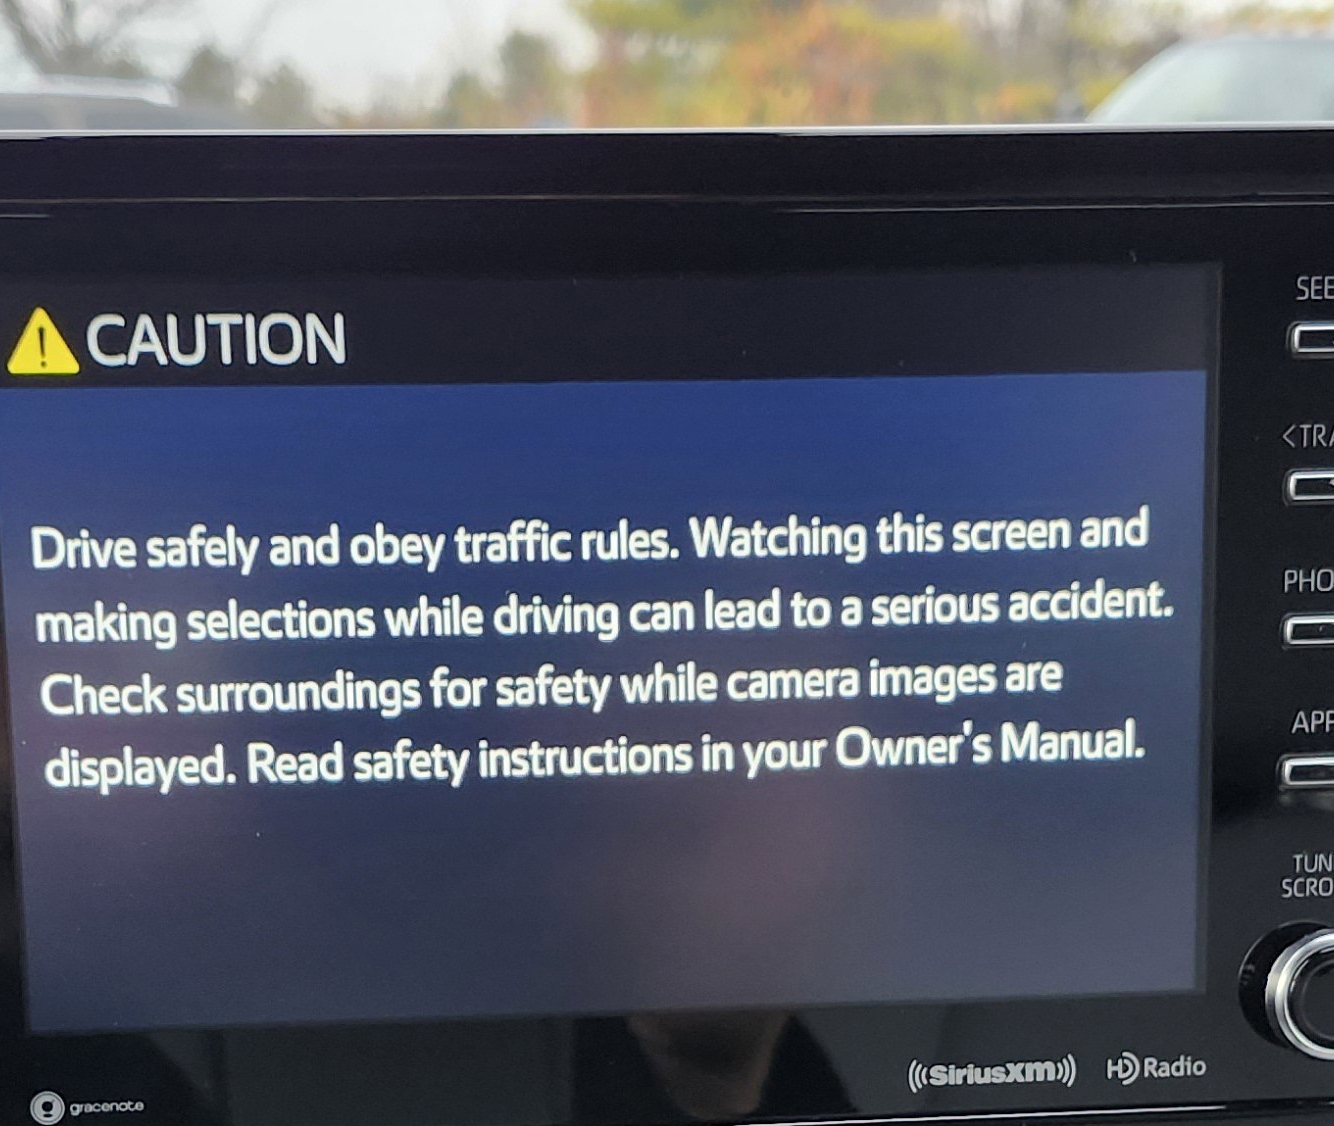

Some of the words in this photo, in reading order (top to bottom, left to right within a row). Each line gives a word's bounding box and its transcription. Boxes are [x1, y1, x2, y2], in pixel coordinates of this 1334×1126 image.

[85, 311, 348, 367] CAUTION
[31, 525, 137, 570] Drive
[147, 524, 259, 575] safely
[269, 523, 339, 565] and
[350, 523, 445, 572] obey
[455, 519, 571, 564] traffic
[582, 518, 679, 560] rules.
[689, 514, 867, 564] Watching
[877, 511, 943, 554] this
[952, 516, 1070, 552] screen
[1080, 505, 1150, 549] and
[36, 601, 176, 650] making
[187, 599, 375, 641] selections
[384, 595, 483, 637] while
[494, 592, 619, 641] driving
[629, 599, 694, 632] can
[704, 588, 780, 631] lead
[791, 592, 831, 628] to
[841, 596, 862, 627] a
[872, 586, 1000, 625] serious
[1009, 578, 1173, 621] accident.
[41, 673, 168, 716] Check
[176, 669, 422, 718] surroundings
[430, 667, 488, 709] for
[496, 663, 611, 713] safety
[621, 661, 717, 703] while
[727, 666, 860, 700] camera
[870, 659, 997, 704] images
[1005, 660, 1063, 693] are
[44, 744, 237, 796] displayed.
[247, 741, 343, 783] Read
[353, 738, 469, 788] safety
[479, 734, 692, 778] instructions
[702, 734, 734, 772] in
[743, 736, 827, 779] your
[835, 720, 992, 767] Owner's
[1000, 718, 1145, 762] Manual.
[1143, 1055, 1206, 1079] Radio
[69, 1100, 144, 1116] gracenote
